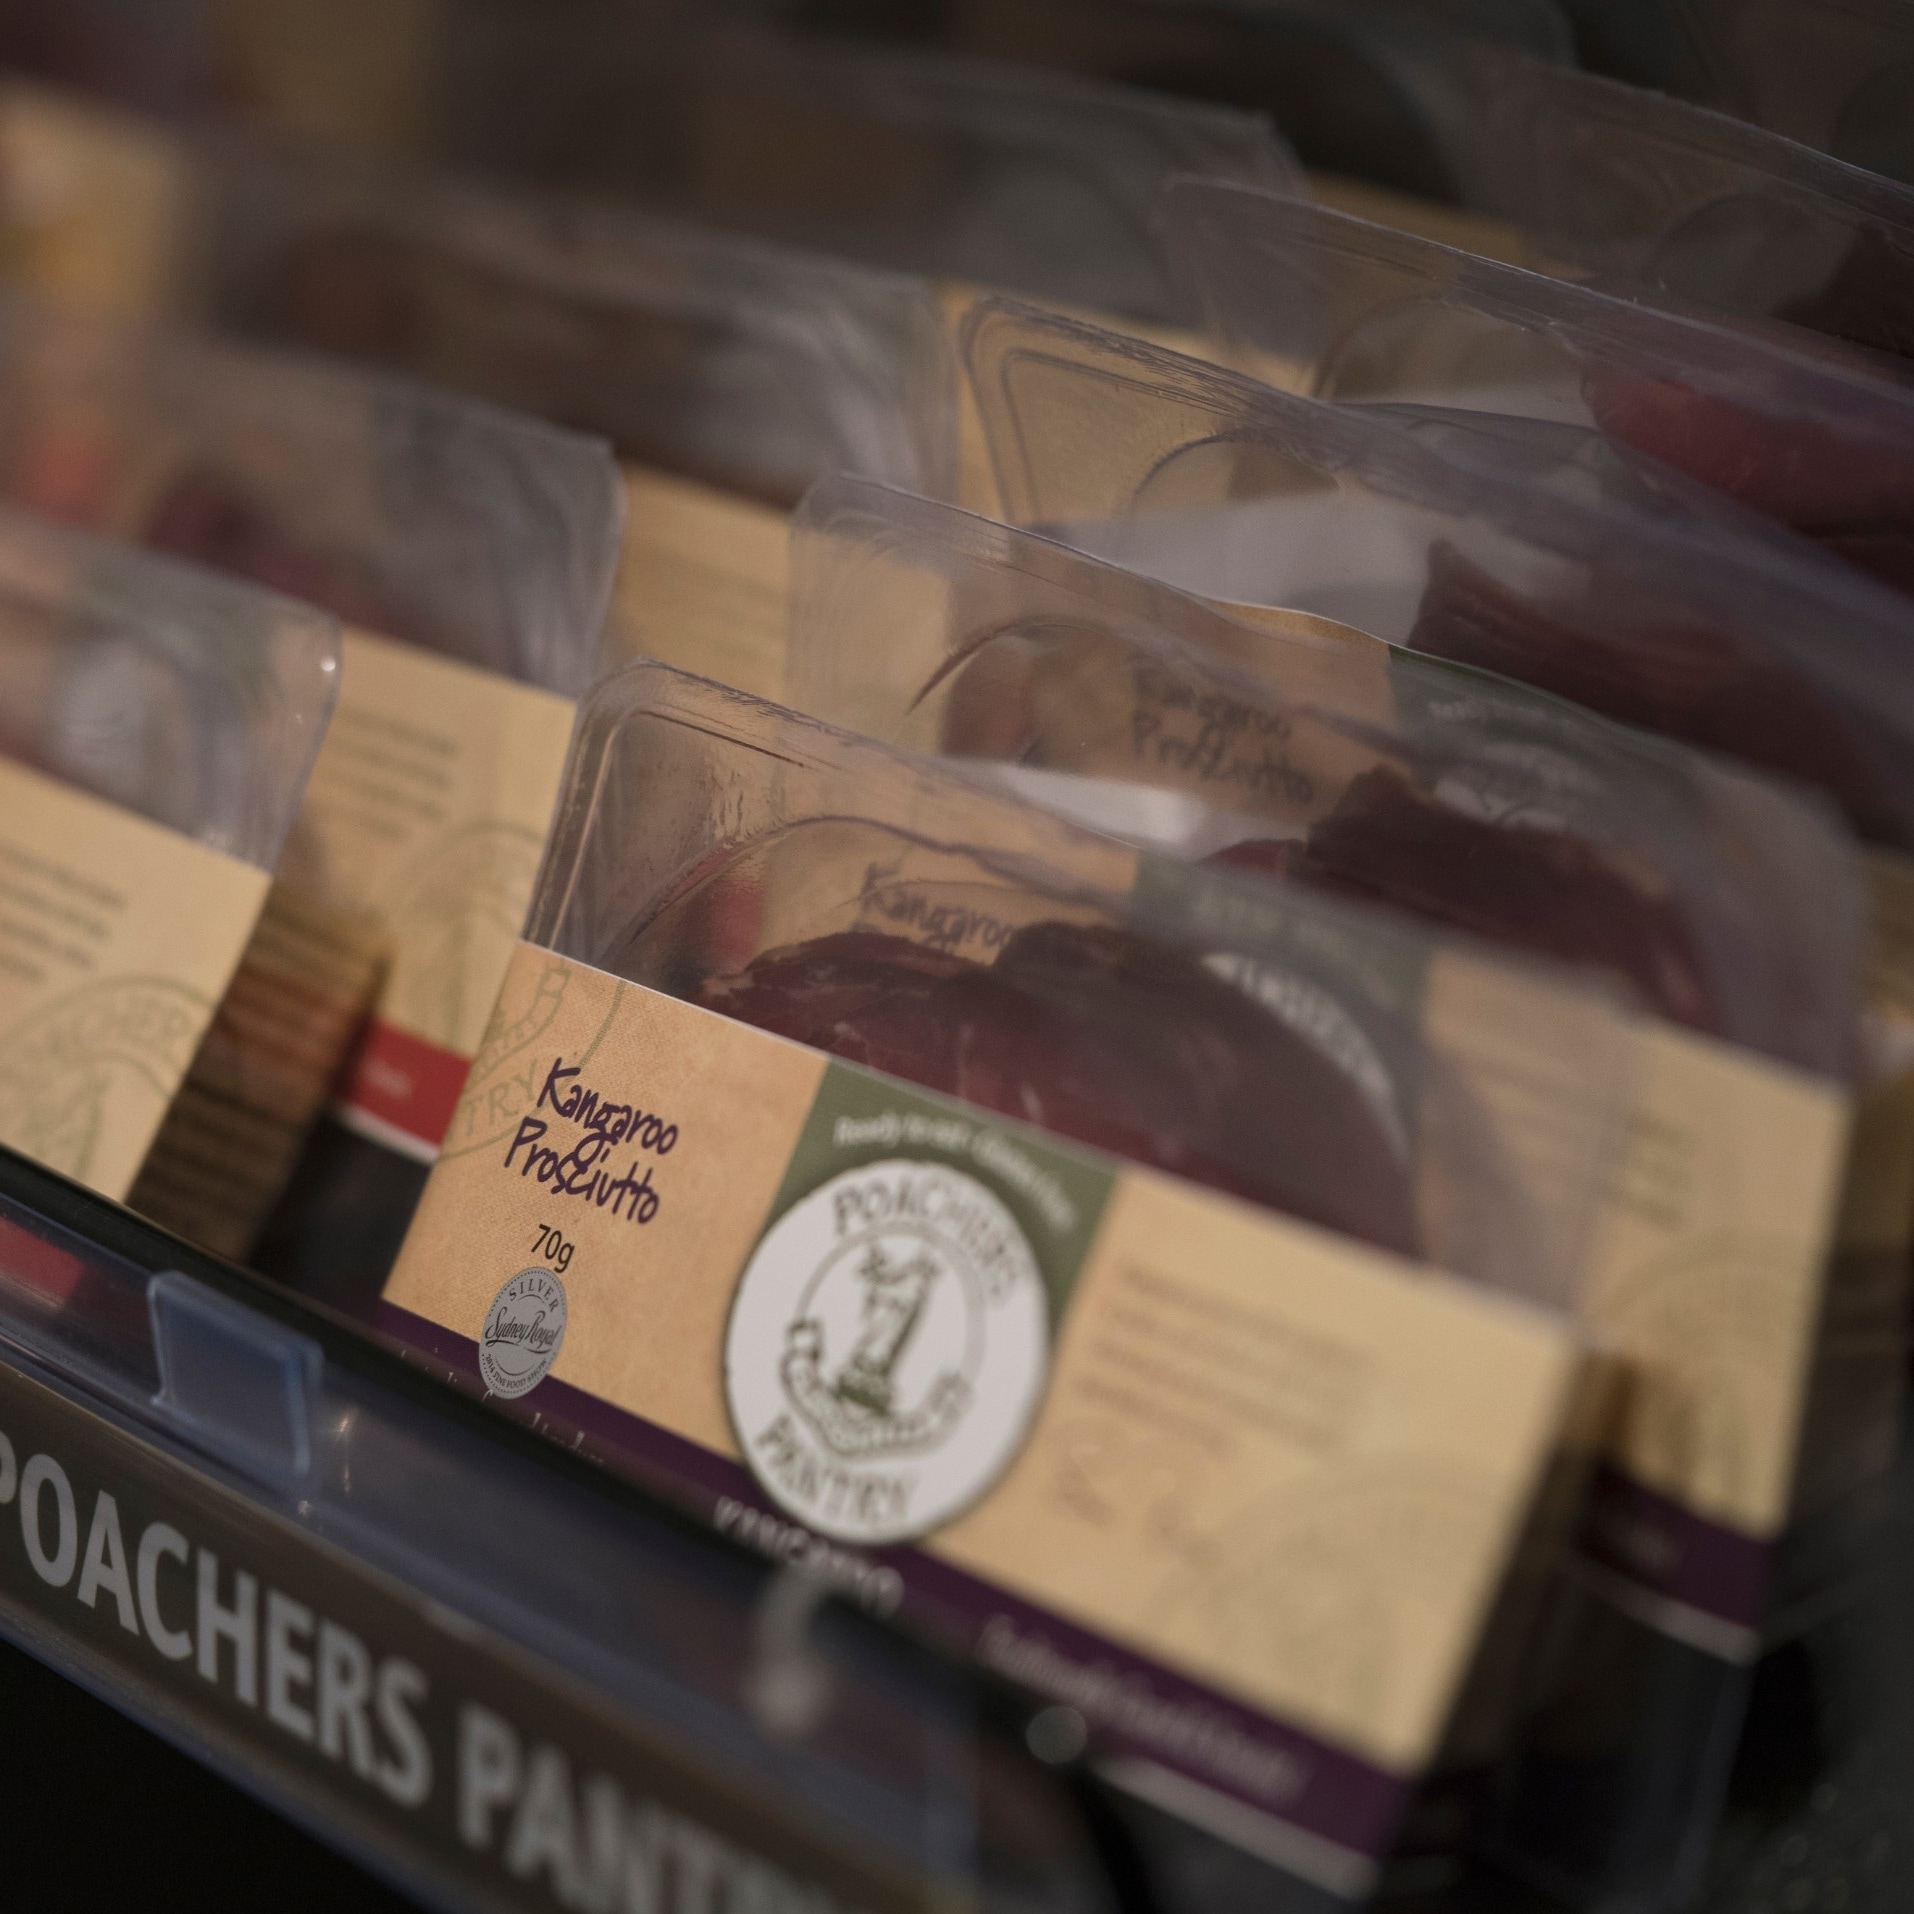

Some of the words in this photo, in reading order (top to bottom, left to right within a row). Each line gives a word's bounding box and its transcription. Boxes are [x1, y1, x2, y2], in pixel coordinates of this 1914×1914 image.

[536, 1057, 679, 1168] Kangaroo
[505, 1115, 660, 1225] Prosciutto
[531, 1223, 575, 1274] 70g
[509, 1278, 559, 1312] SILVER
[485, 1306, 527, 1345] Sydney
[527, 1310, 562, 1349] Royal
[492, 1371, 507, 1387] FINE
[506, 1377, 526, 1390] FOOD
